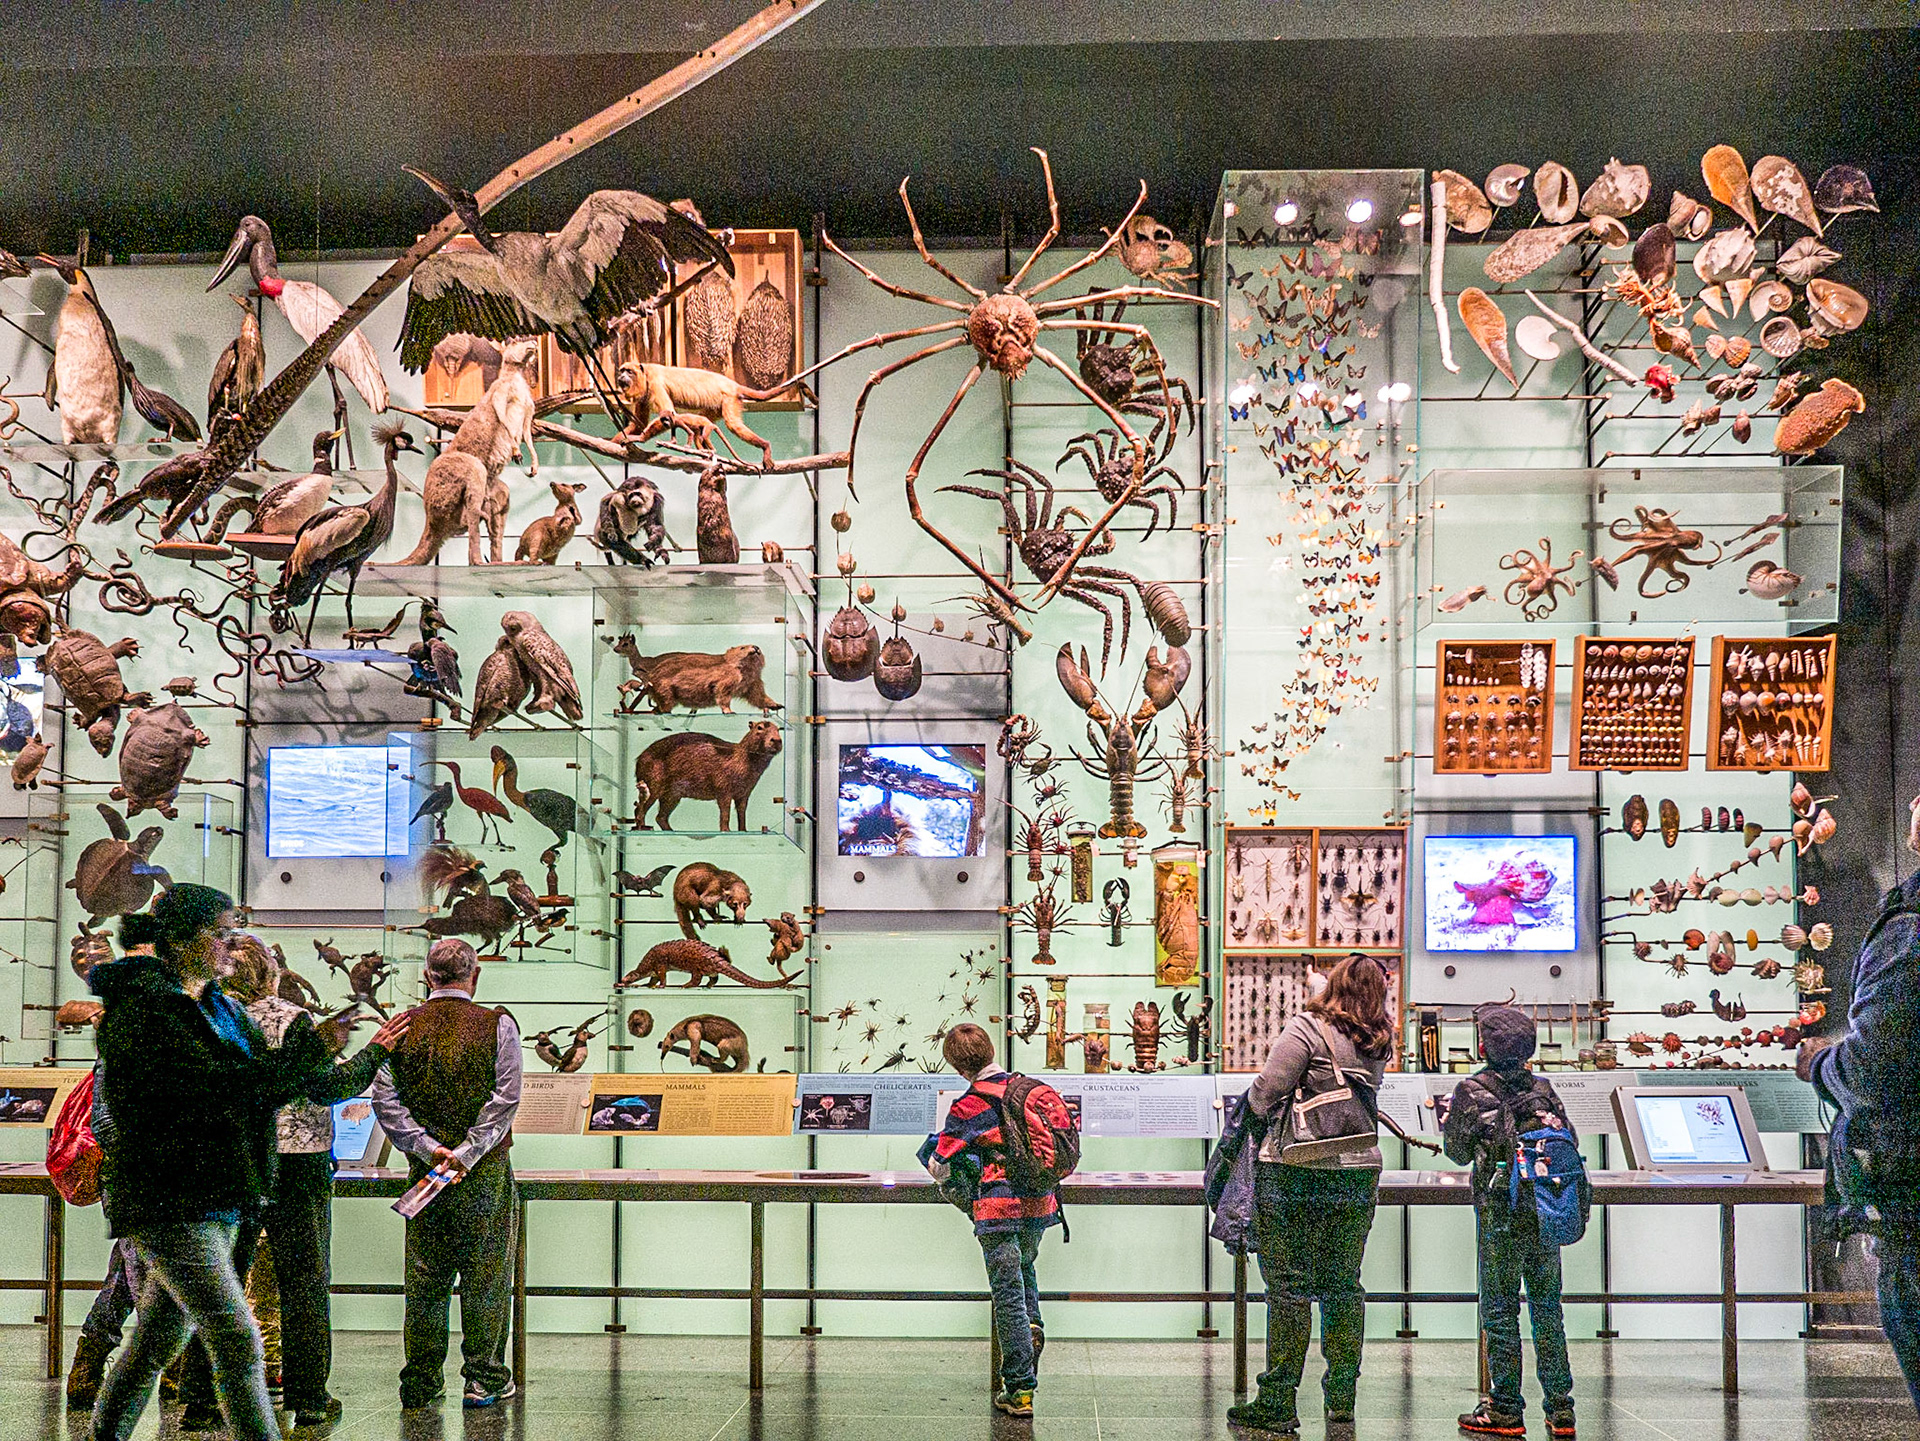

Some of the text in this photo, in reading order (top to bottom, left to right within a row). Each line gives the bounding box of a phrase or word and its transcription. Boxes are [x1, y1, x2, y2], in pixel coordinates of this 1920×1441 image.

[850, 845, 896, 854] MAMMALS
[530, 1082, 555, 1090] BIRDS
[665, 1083, 706, 1091] MAMMALS
[873, 1083, 932, 1091] CHELICERATES
[1082, 1084, 1141, 1092] CRUSTACEANS
[1554, 1081, 1586, 1089] WORMS
